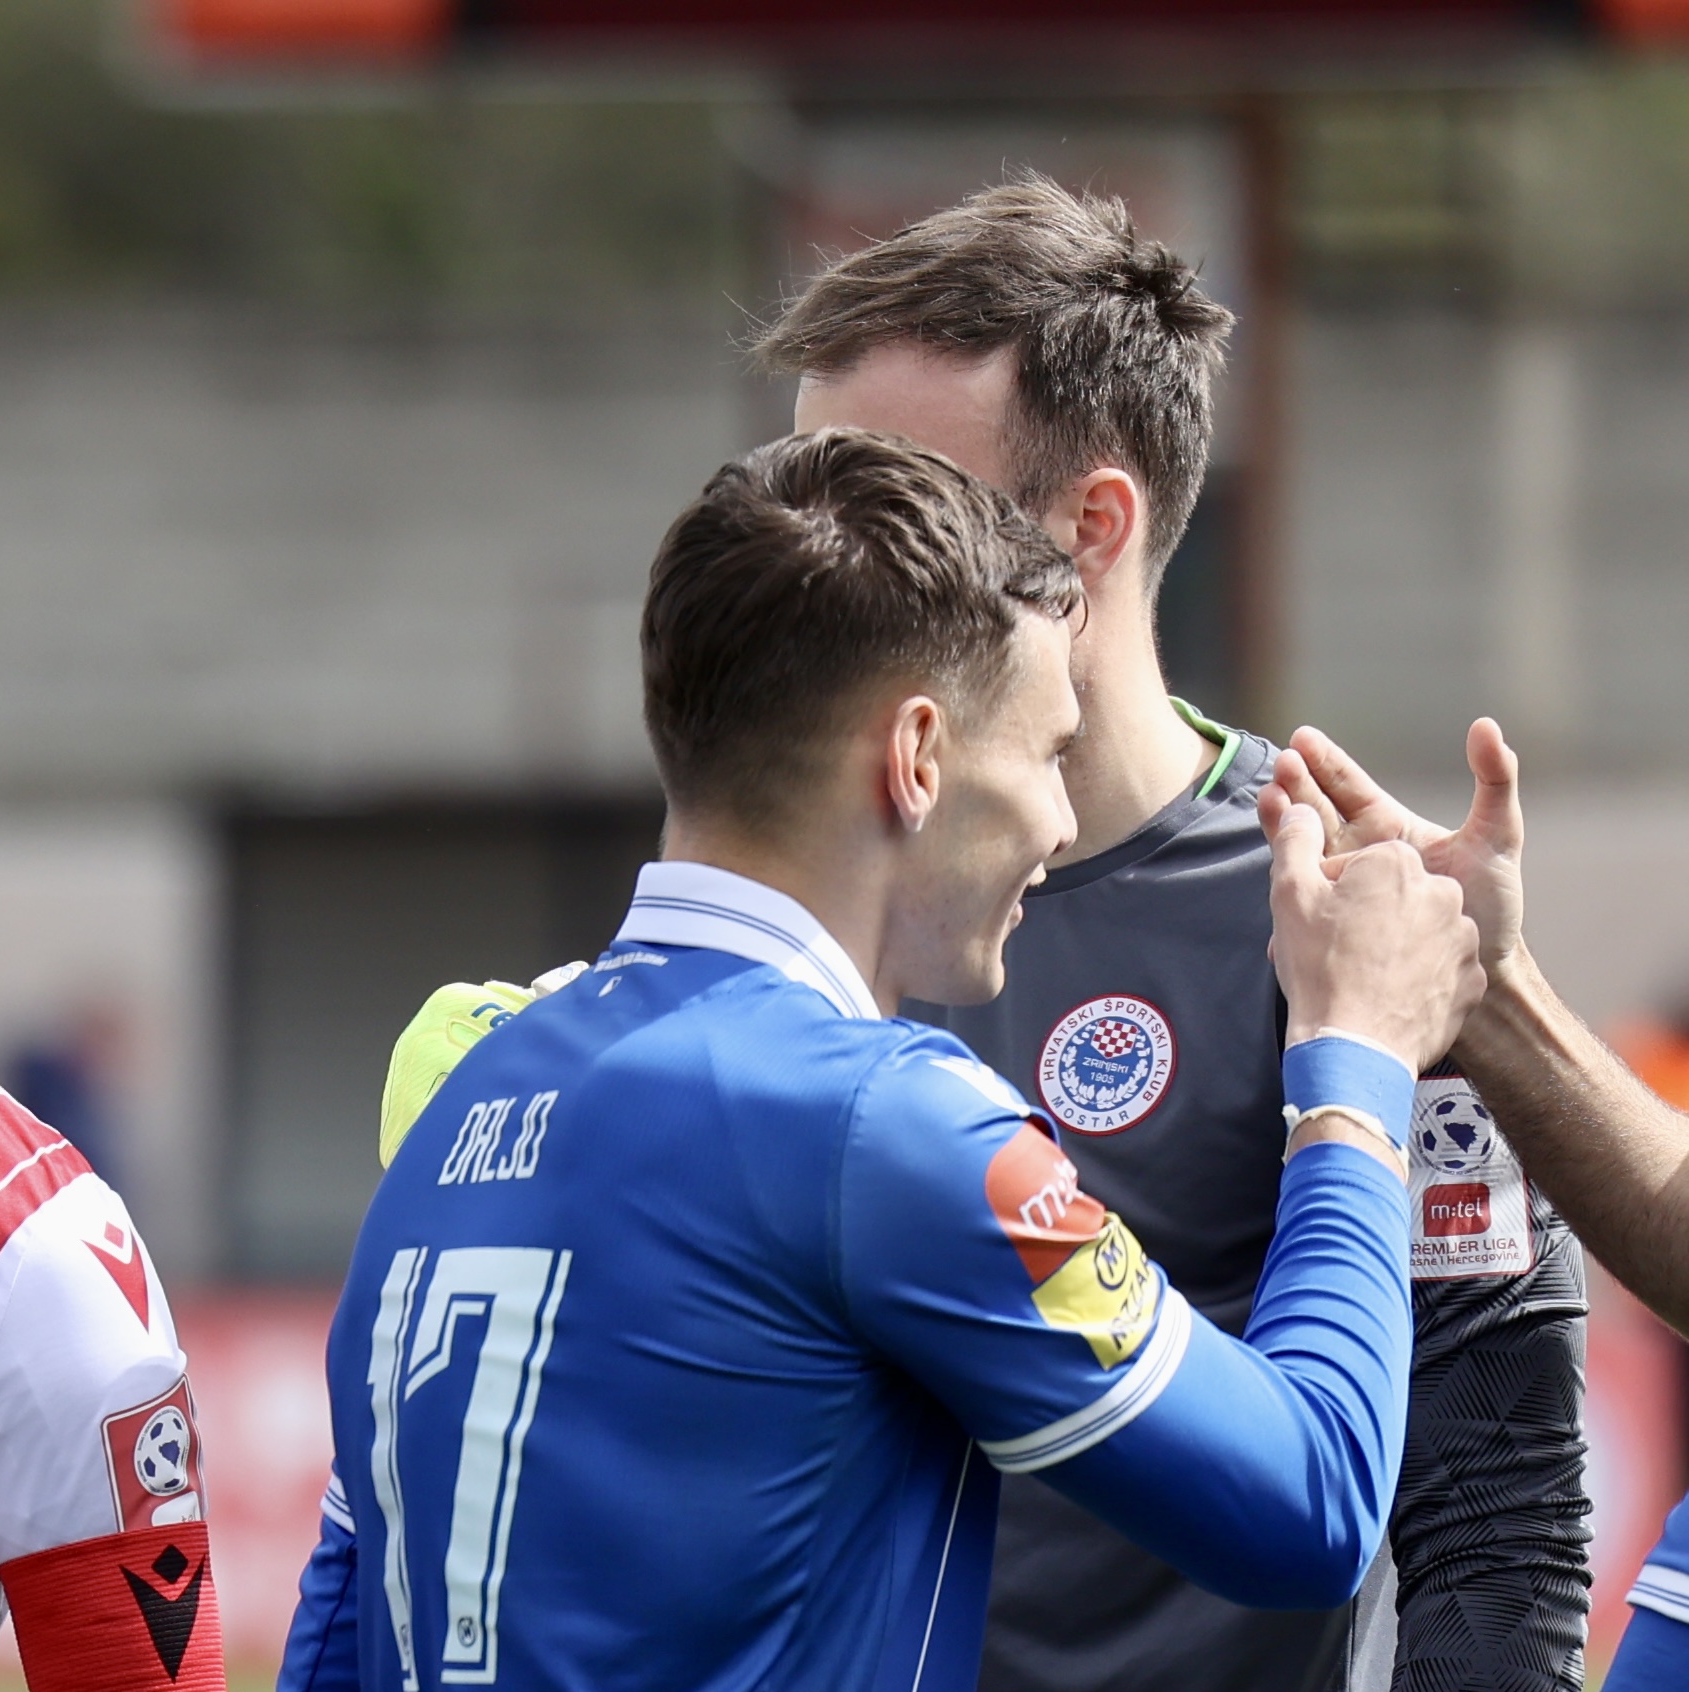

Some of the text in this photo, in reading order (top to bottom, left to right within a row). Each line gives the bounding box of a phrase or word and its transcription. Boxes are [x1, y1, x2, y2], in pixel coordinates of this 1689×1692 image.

[1044, 999, 1168, 1102] HRVATSKI ŠPORTSKI KLUB
[1090, 1072, 1114, 1084] 1905
[1051, 1096, 1130, 1128] MOSTAR
[1431, 1197, 1483, 1220] m:tel
[1411, 1238, 1519, 1255] REMIJER LIGA
[1447, 1252, 1520, 1266] Hercegovine
[367, 1246, 573, 1692] 17
